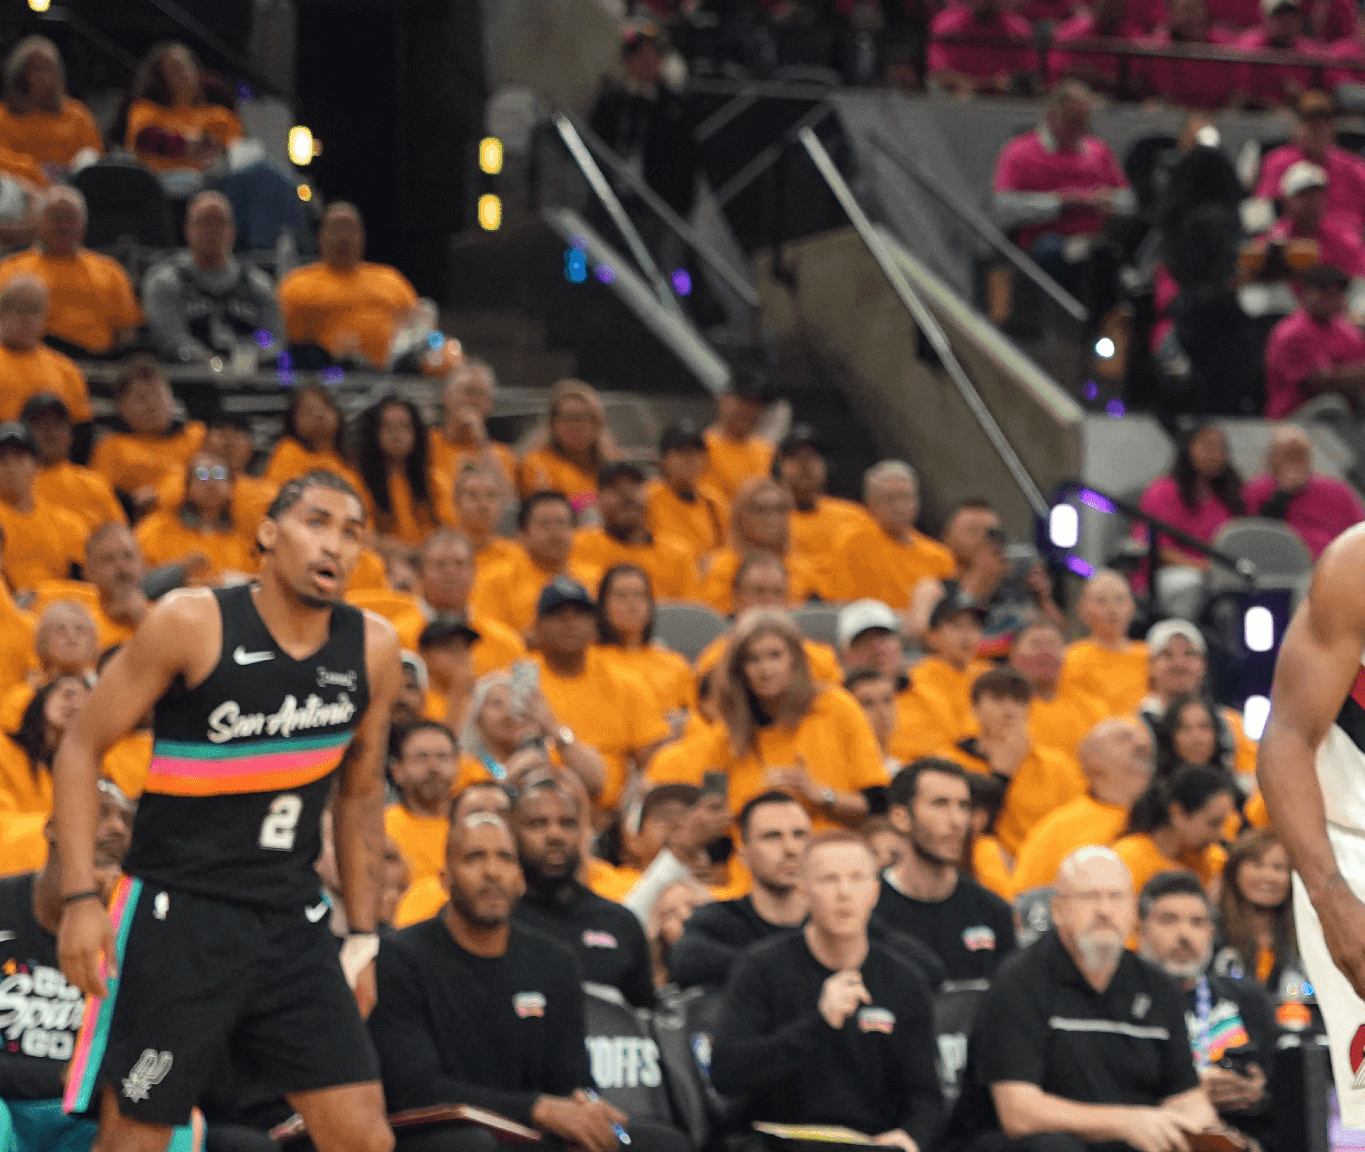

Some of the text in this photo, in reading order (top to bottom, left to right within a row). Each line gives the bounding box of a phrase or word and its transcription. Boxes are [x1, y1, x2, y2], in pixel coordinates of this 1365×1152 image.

[207, 692, 356, 744] San Antonio
[258, 794, 303, 852] 2
[21, 1028, 74, 1060] GO
